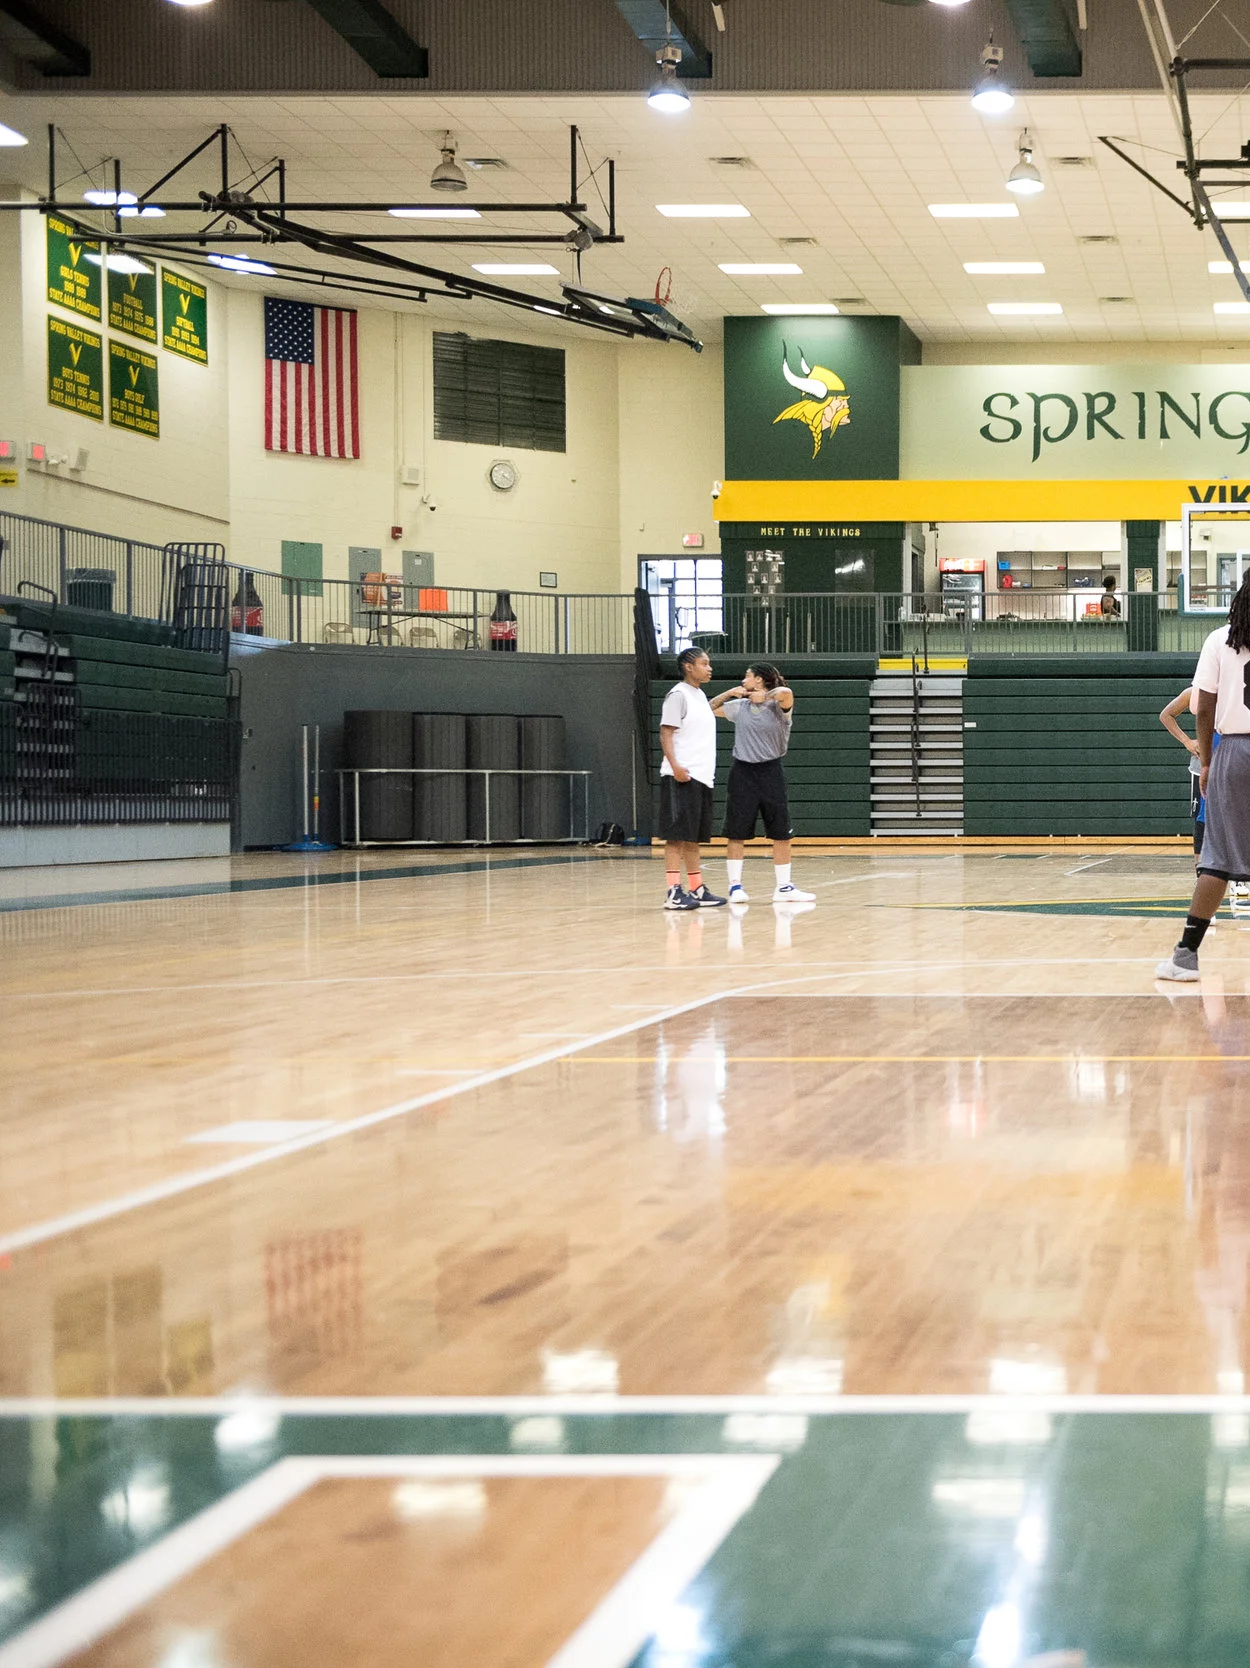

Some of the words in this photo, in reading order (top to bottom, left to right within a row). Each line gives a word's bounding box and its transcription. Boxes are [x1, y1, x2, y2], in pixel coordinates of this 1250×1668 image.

[761, 527, 785, 536] MEET
[793, 527, 811, 536] THE
[818, 527, 861, 537] VIKINGS
